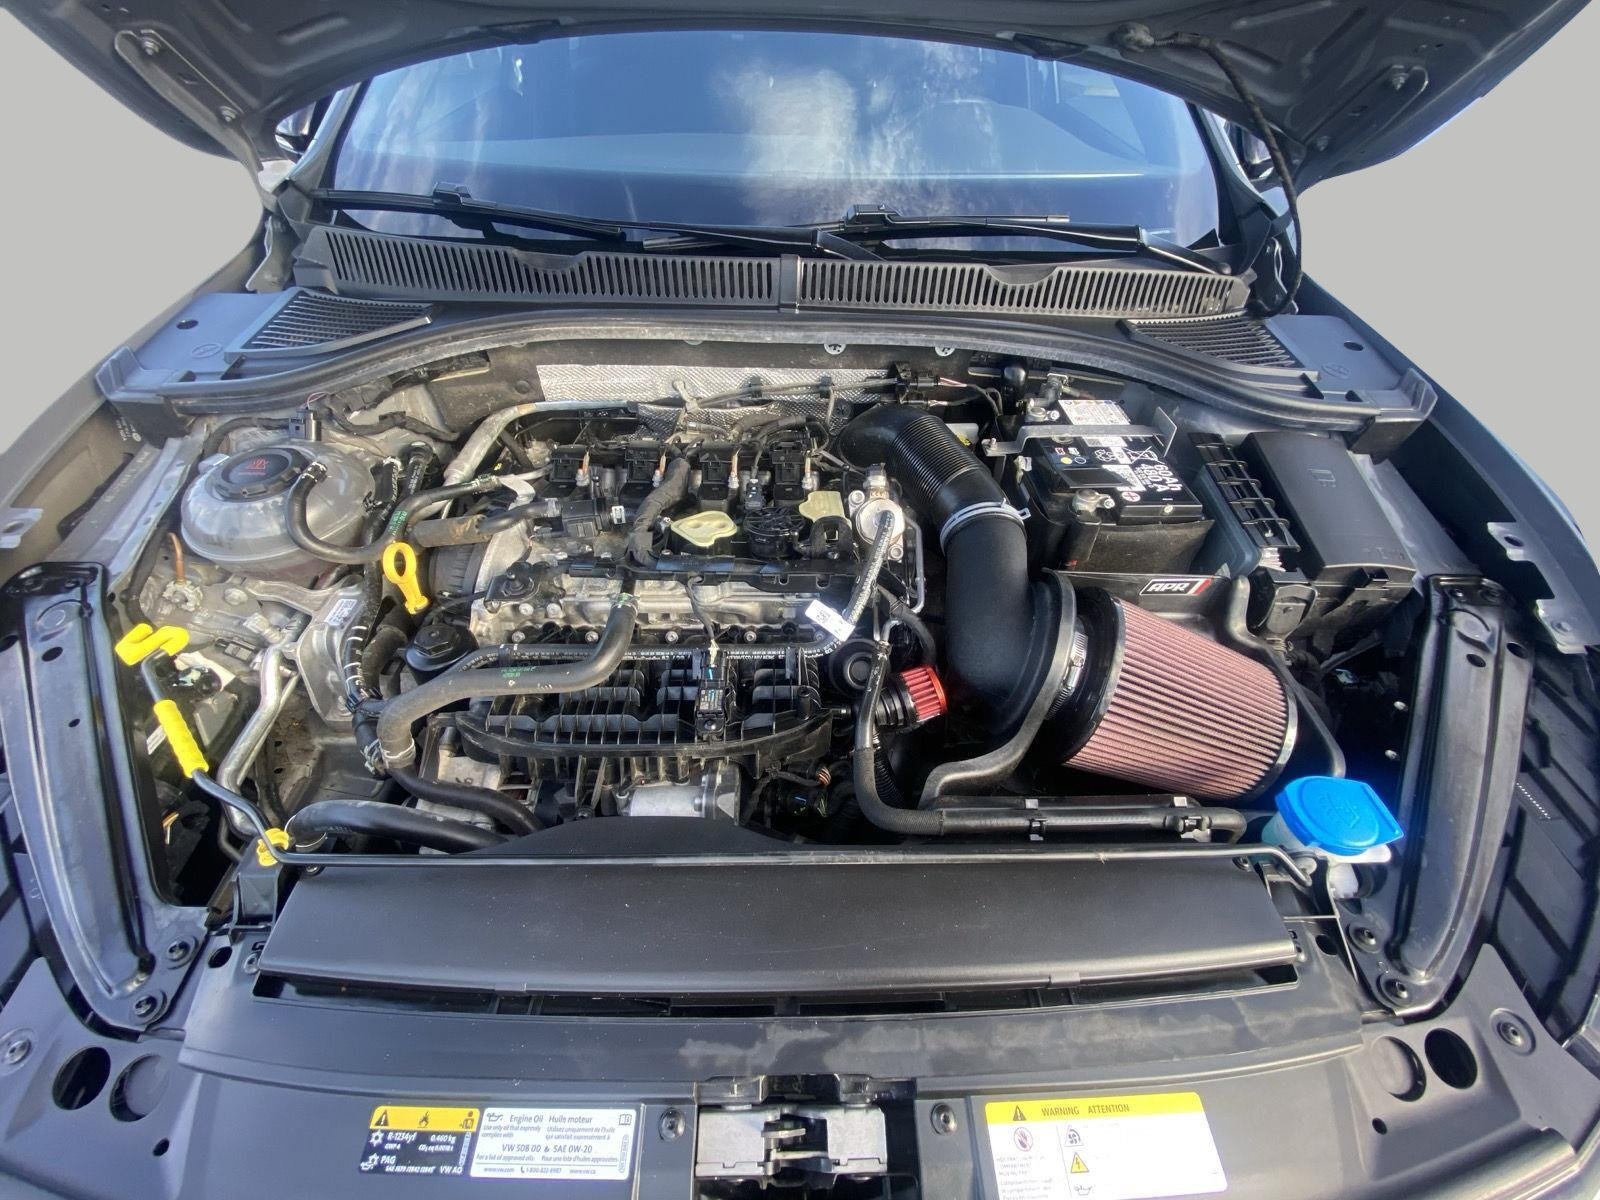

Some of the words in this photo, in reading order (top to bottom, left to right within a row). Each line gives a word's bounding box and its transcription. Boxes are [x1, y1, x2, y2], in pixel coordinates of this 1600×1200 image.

[1147, 582, 1190, 592] APR
[1041, 1105, 1080, 1117] WARNING
[1087, 1103, 1130, 1114] ATTENTION
[509, 1114, 532, 1124] Engine
[533, 1114, 544, 1123] Oil
[548, 1114, 566, 1124] Huile
[567, 1115, 593, 1124] moteur
[387, 1131, 417, 1144] R-1234yf
[502, 1144, 515, 1152] VW
[543, 1145, 550, 1153] &
[552, 1144, 567, 1153] SAE
[568, 1144, 593, 1153] 0W-20
[380, 1156, 396, 1164] PAG
[440, 1166, 451, 1174] VW
[451, 1166, 463, 1175] AG
